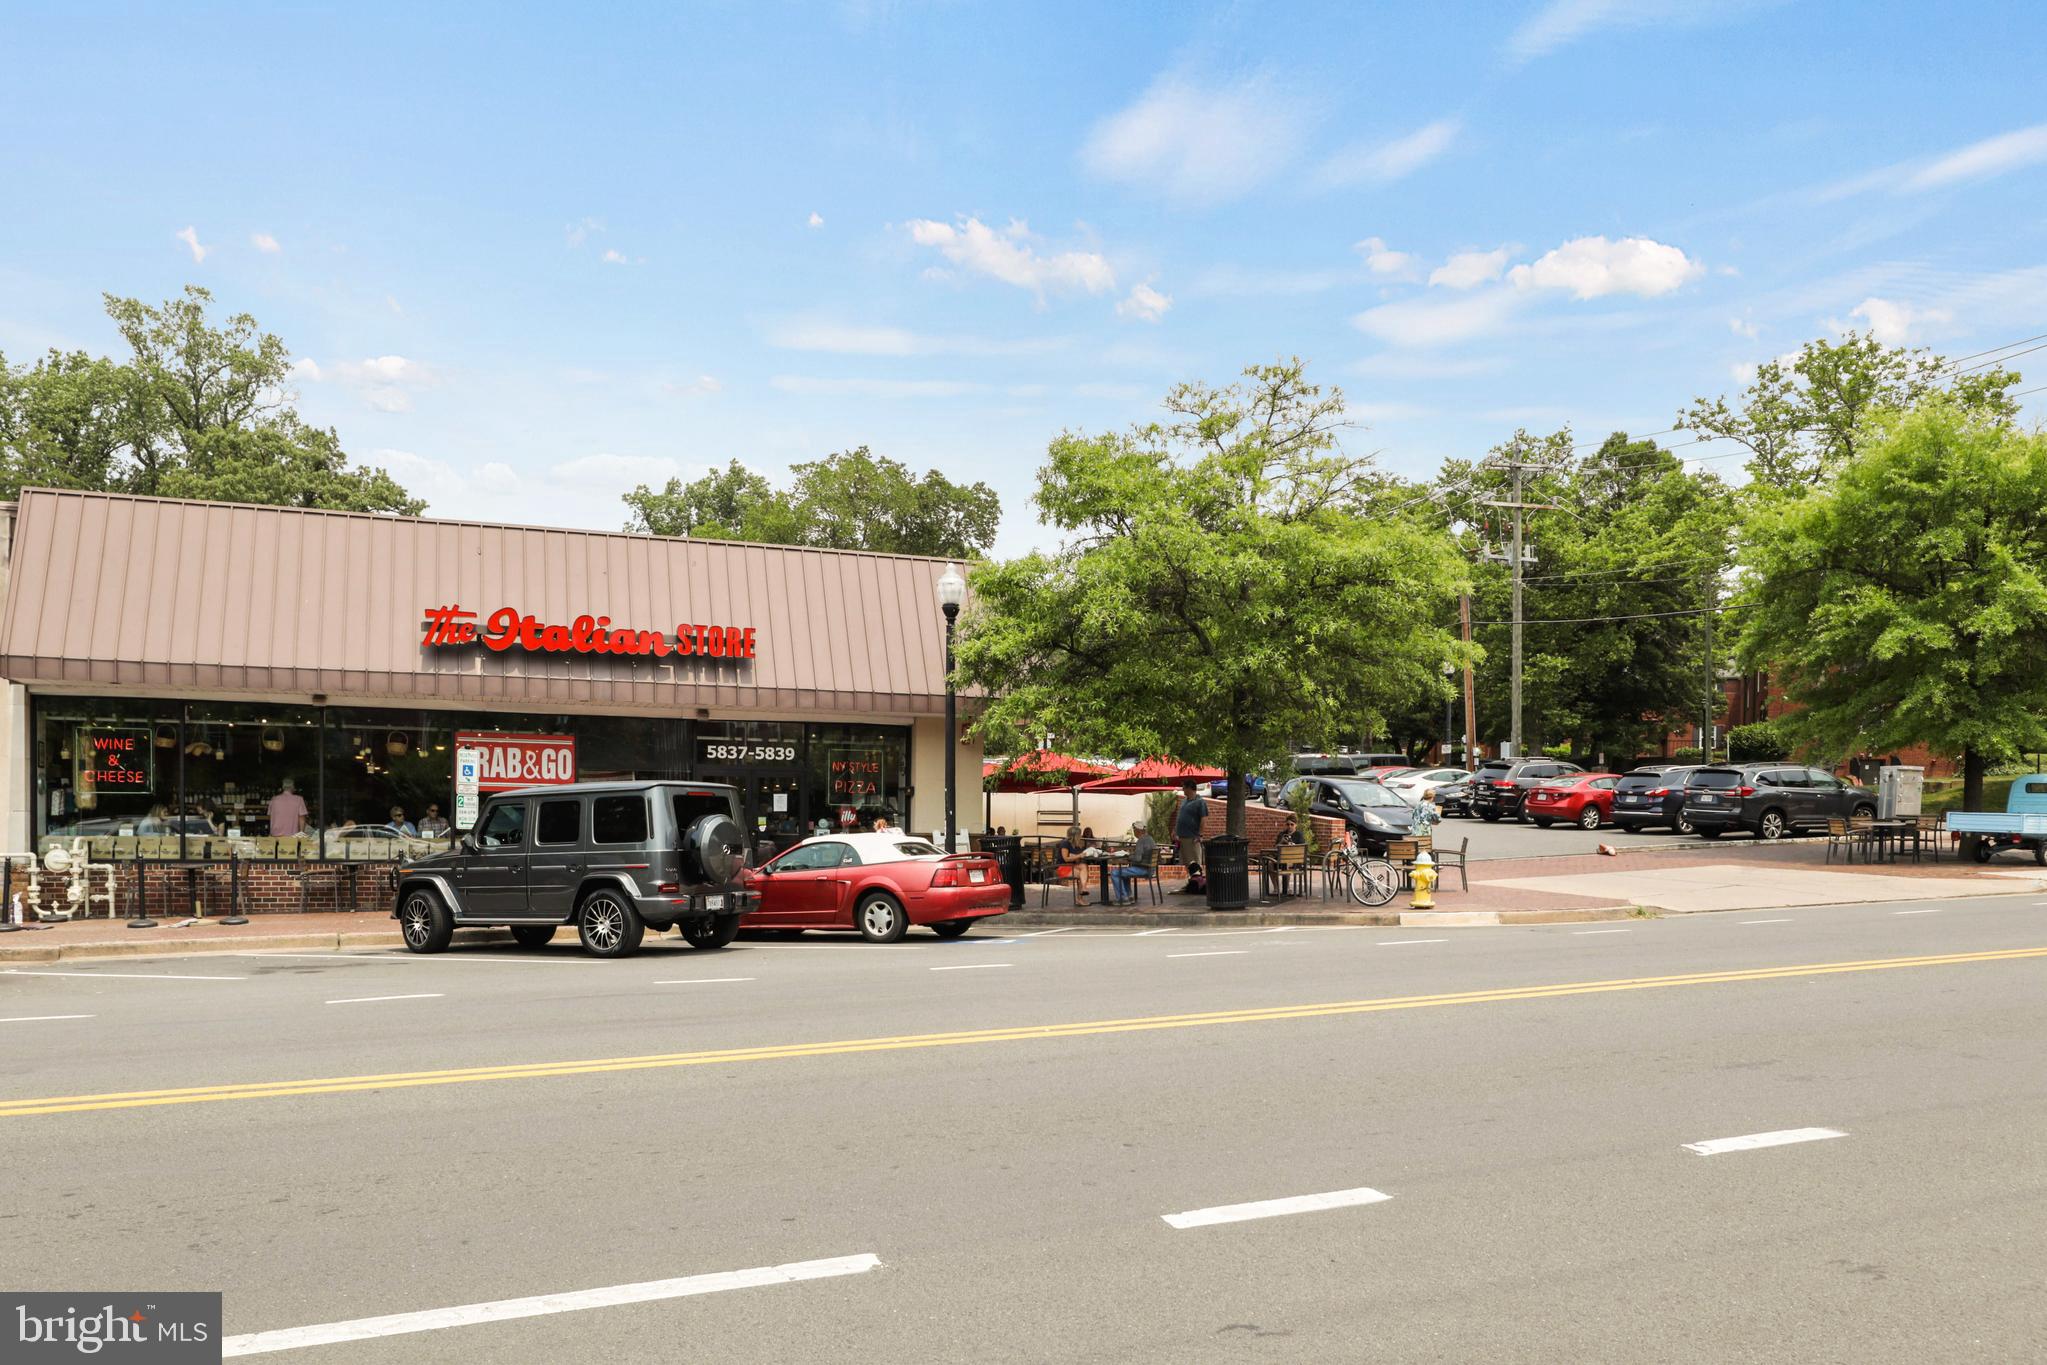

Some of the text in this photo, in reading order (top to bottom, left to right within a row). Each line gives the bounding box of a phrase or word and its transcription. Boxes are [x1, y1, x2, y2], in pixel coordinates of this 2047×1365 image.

[422, 604, 757, 659] The Italian STORE
[94, 738, 135, 750] WINE
[706, 745, 795, 761] 5837-5839
[108, 754, 119, 767] &
[475, 746, 573, 780] RAB&GO
[848, 761, 880, 773] STYLE
[84, 770, 144, 783] CHEESE
[834, 780, 877, 794] PIZZA
[840, 810, 857, 824] illy
